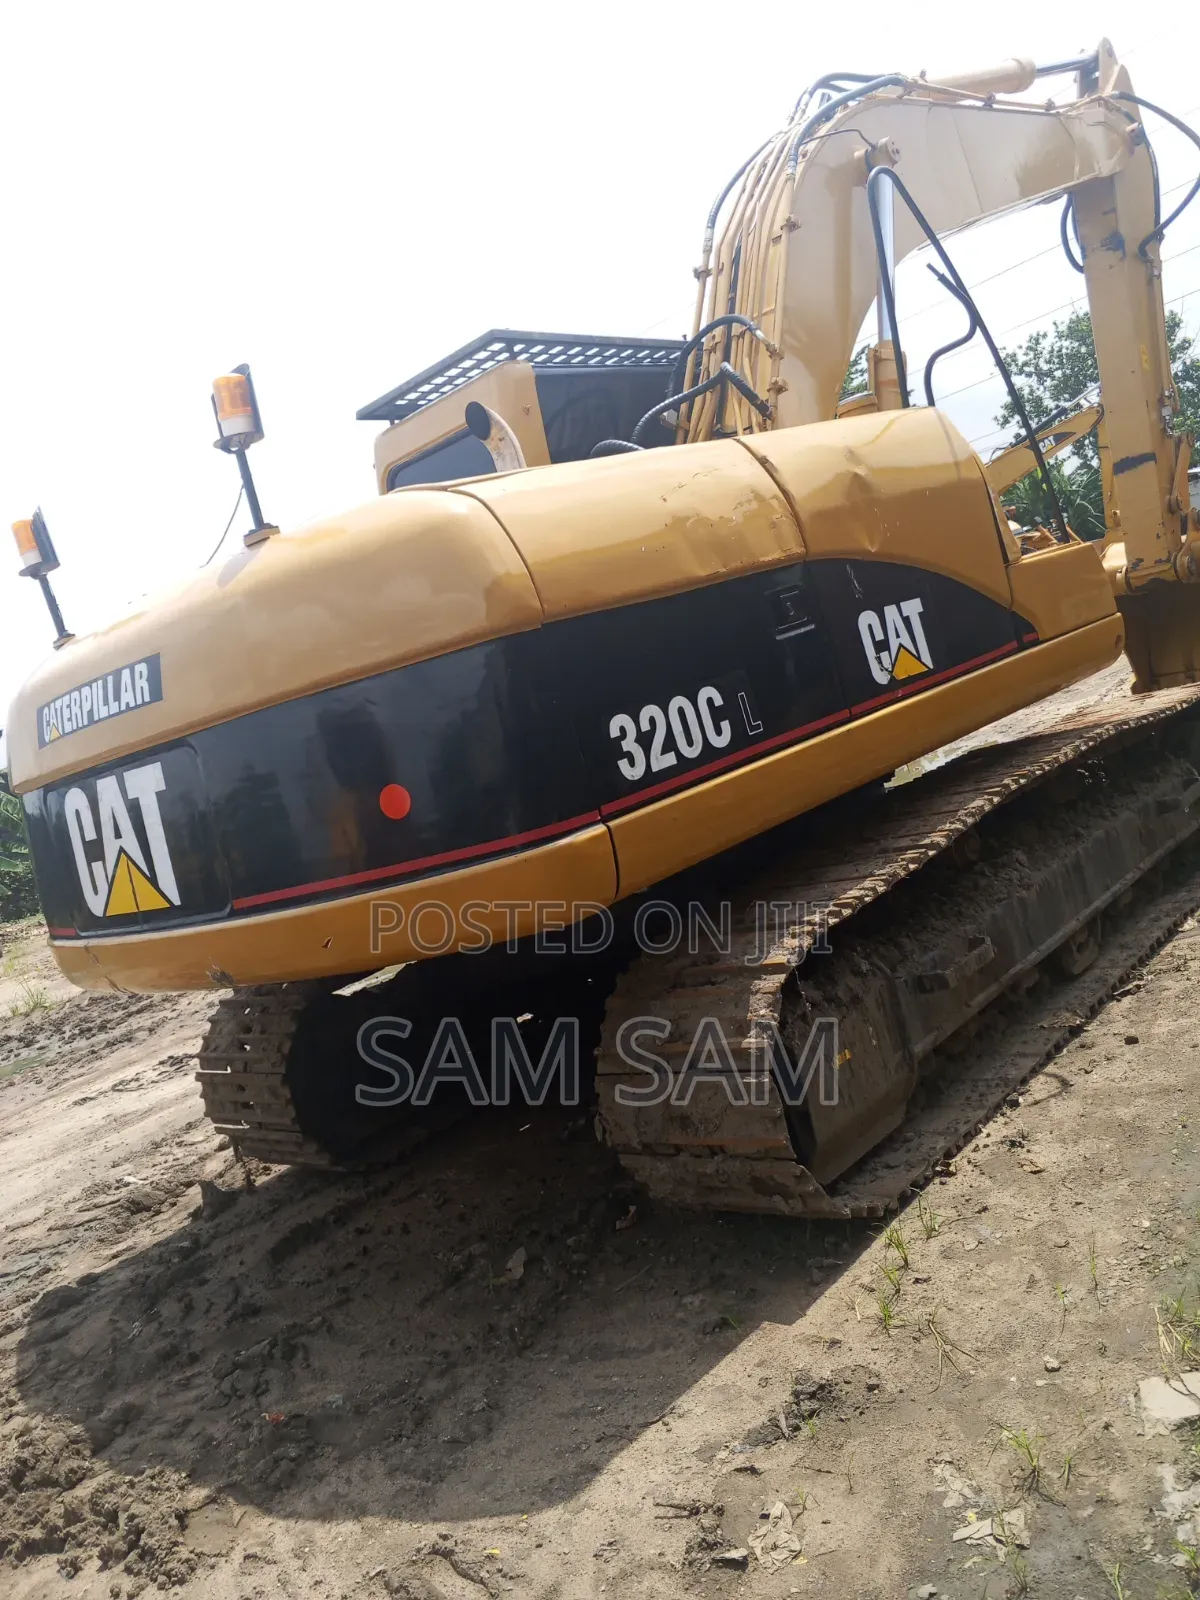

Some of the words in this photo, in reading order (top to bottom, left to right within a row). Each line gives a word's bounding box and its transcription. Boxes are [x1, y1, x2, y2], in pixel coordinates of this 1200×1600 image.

[1039, 435, 1056, 453] CAT
[858, 597, 934, 684] CAT
[43, 662, 150, 742] CATERPILLAR
[609, 686, 732, 781] 320C
[737, 692, 763, 735] L
[64, 761, 181, 917] CAT
